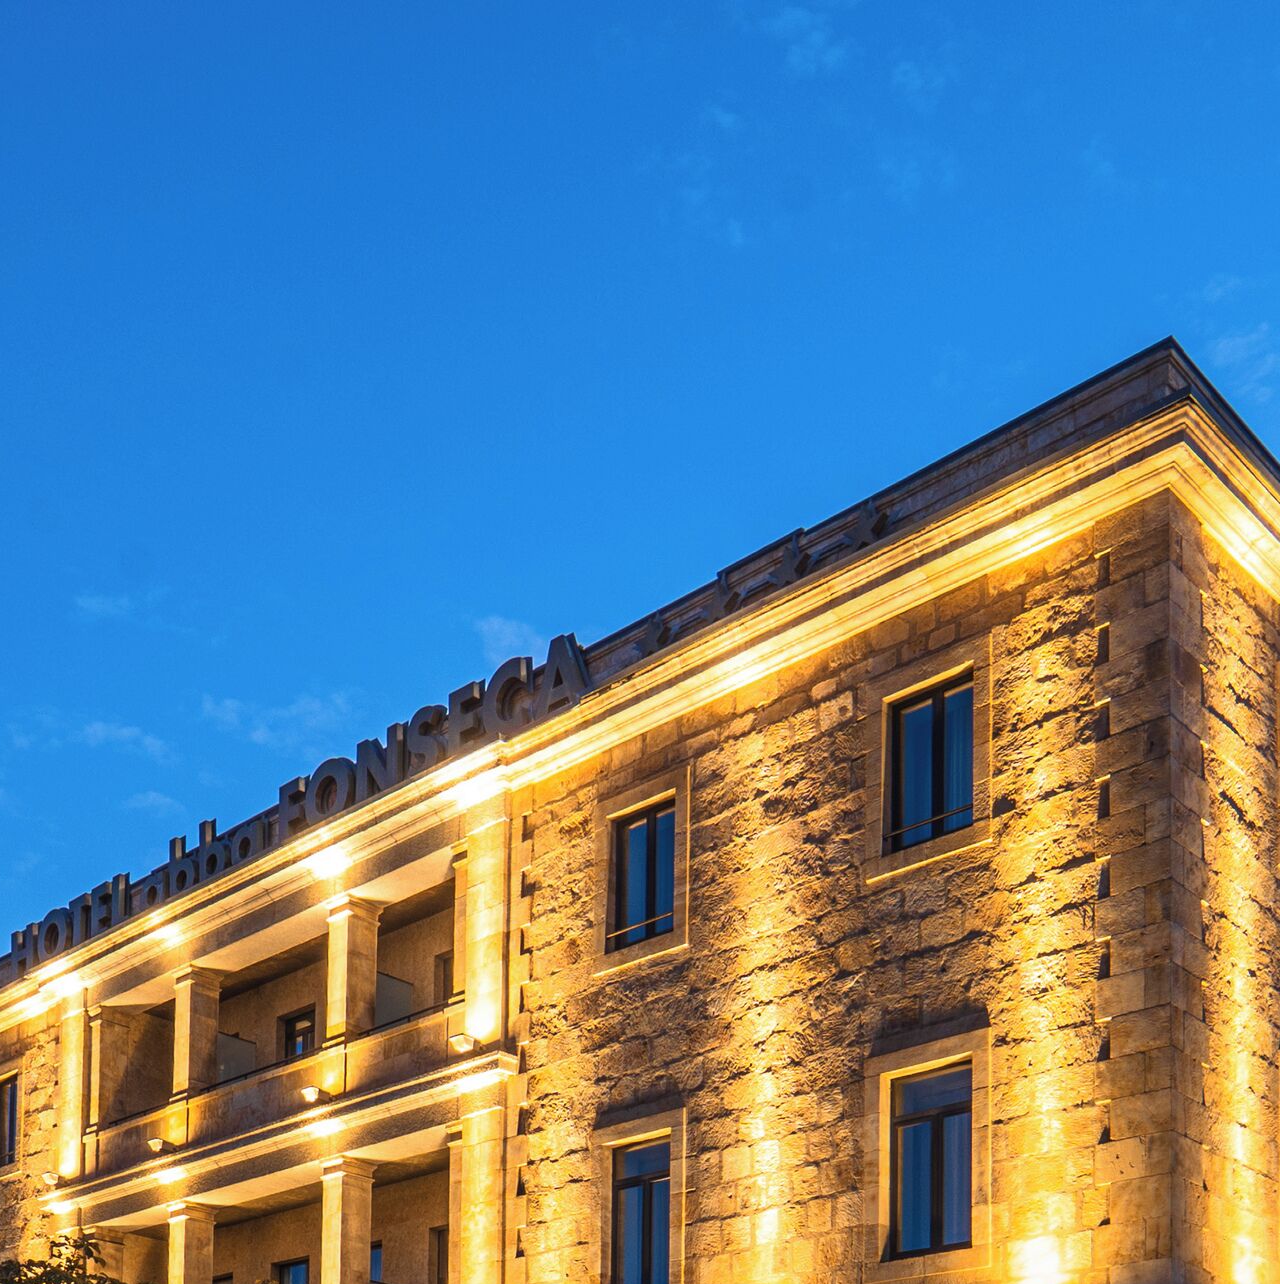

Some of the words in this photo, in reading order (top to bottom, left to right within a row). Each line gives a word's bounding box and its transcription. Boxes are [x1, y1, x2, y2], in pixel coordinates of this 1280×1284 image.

[11, 872, 130, 979] HOTEL
[143, 818, 268, 907] abba
[279, 633, 593, 842] FONSECA
